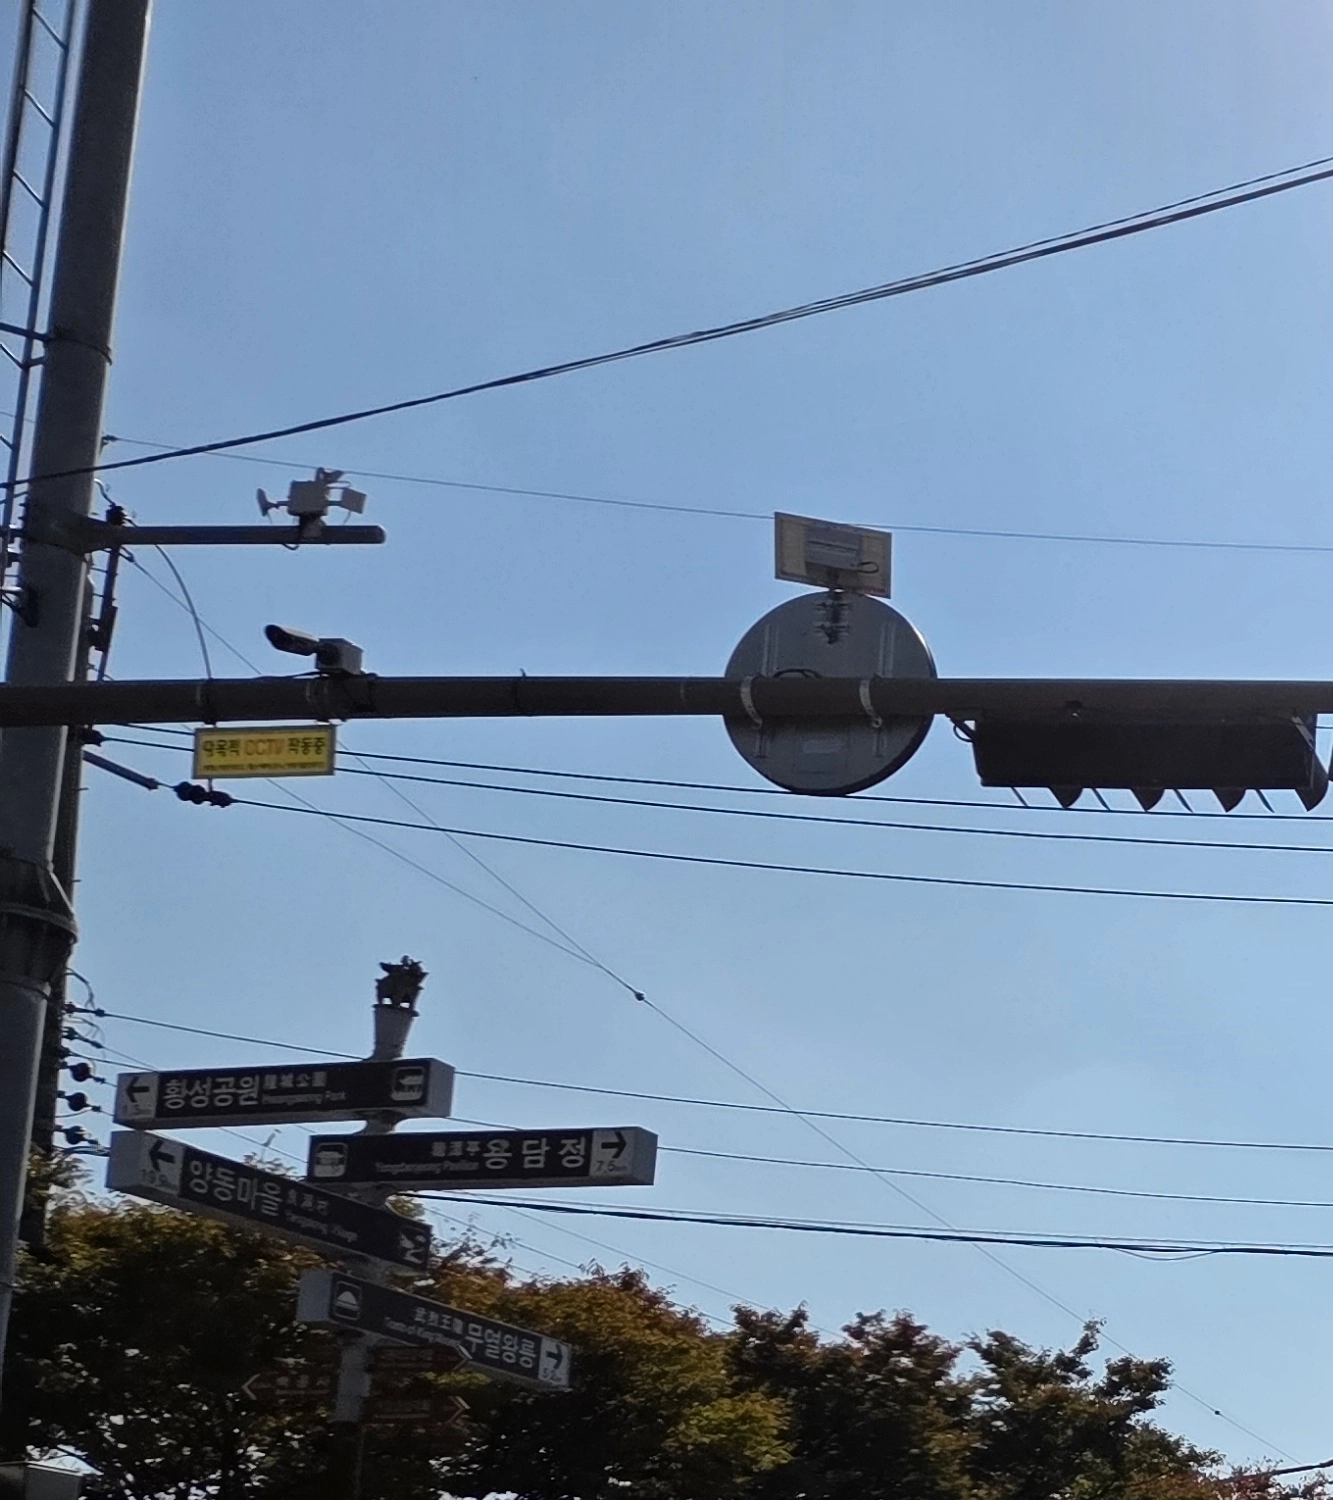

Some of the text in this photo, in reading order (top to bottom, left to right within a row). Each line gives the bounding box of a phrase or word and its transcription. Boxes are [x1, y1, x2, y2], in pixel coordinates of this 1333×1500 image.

[163, 1074, 260, 1110] 황성공원
[482, 1136, 588, 1170] 용담정
[188, 1160, 282, 1218] 양동마을
[463, 1323, 536, 1370] 무열왕릉
